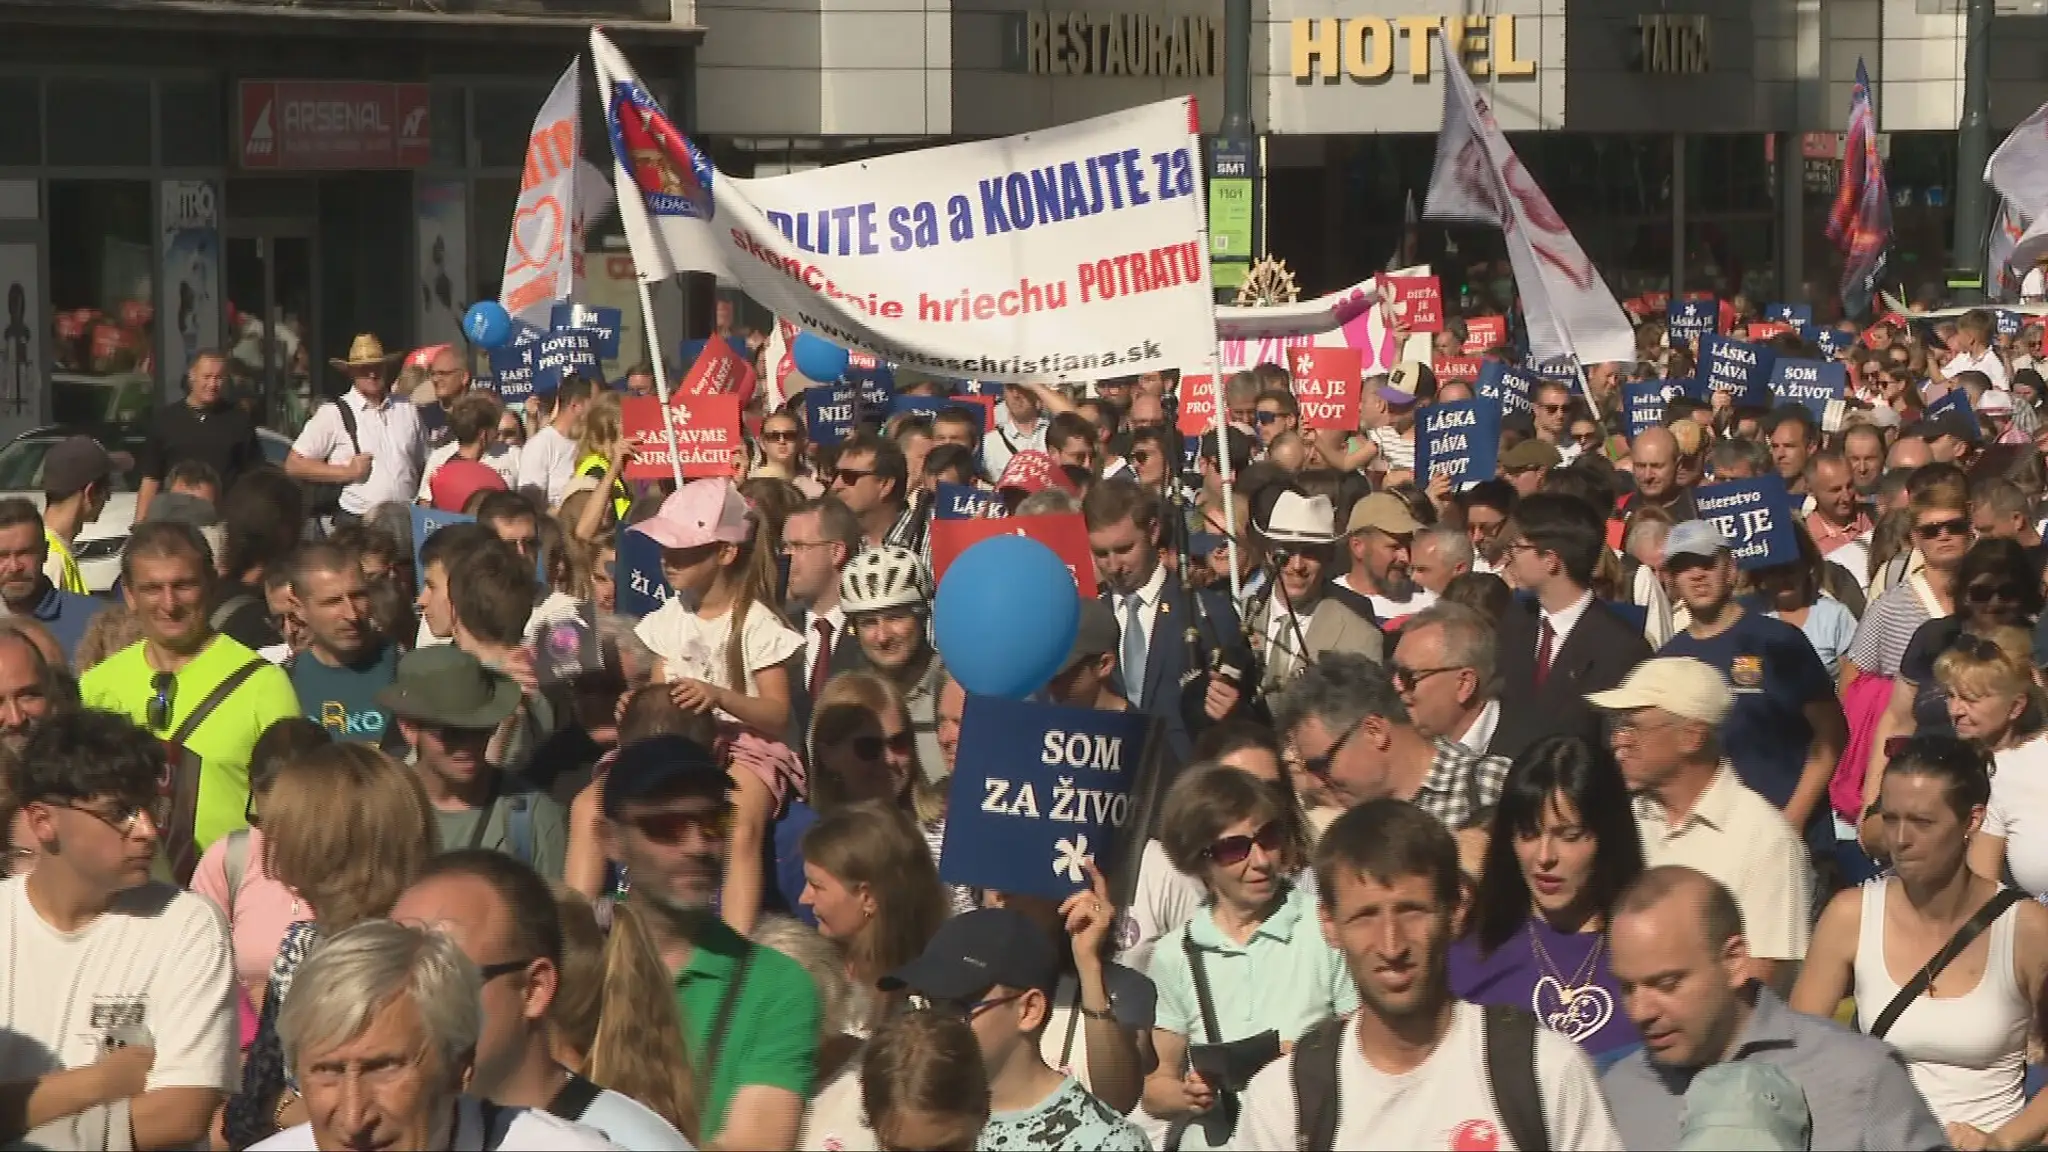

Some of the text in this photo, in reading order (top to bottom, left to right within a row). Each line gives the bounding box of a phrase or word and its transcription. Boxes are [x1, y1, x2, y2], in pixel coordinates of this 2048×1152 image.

[1026, 9, 1225, 77] RESTAURANT
[1290, 13, 1537, 82] HOTEL
[285, 100, 391, 133] ARSENAL
[1216, 163, 1246, 175] SM1
[888, 201, 940, 252] sa
[947, 194, 974, 242] a
[978, 148, 1151, 237] KONAJTE
[1151, 148, 1195, 201] za
[918, 276, 1068, 323] hriechu
[1077, 240, 1201, 304] POTRATU
[1710, 341, 1758, 365] LÁSKA
[1434, 362, 1478, 375] LÁSKA
[1711, 361, 1748, 381] DÁVA
[1785, 367, 1818, 381] SOM
[1192, 383, 1226, 397] LOV
[1325, 380, 1346, 398] JE
[1480, 384, 1499, 400] ZA
[1501, 373, 1531, 393] SOM
[1788, 382, 1834, 400] ŽIVOT
[817, 404, 853, 423] NIE
[1426, 409, 1477, 434] LÁSKA
[1430, 434, 1469, 457] DÁVA
[1739, 508, 1774, 542] JE
[1040, 729, 1123, 771] SOM
[980, 777, 1041, 819] ZA
